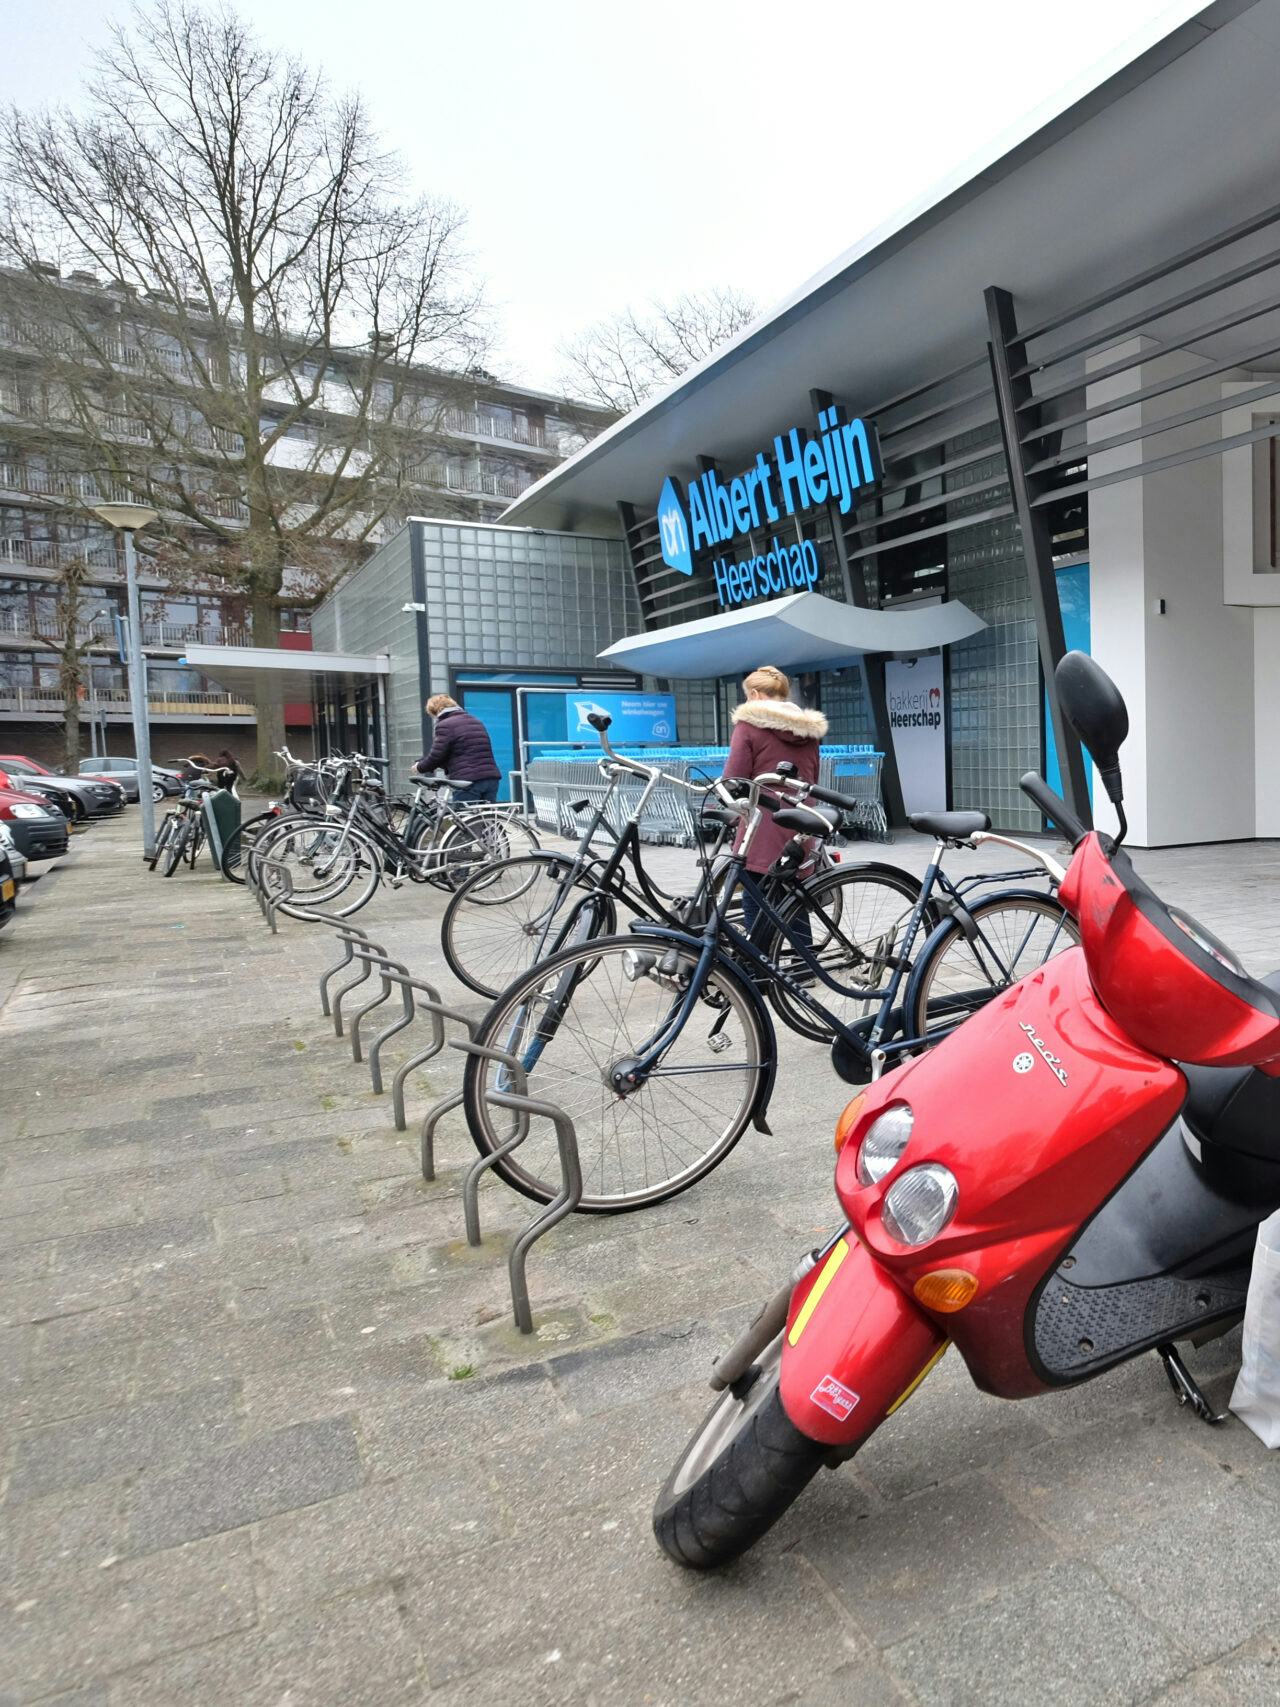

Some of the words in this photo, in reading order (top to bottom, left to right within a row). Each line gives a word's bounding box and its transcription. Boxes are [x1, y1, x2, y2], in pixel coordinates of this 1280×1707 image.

[688, 452, 779, 550] Albert
[774, 405, 874, 514] Heijn
[713, 537, 819, 606] Heerschap
[890, 689, 928, 712] bakkerij
[890, 709, 941, 730] Heerschap
